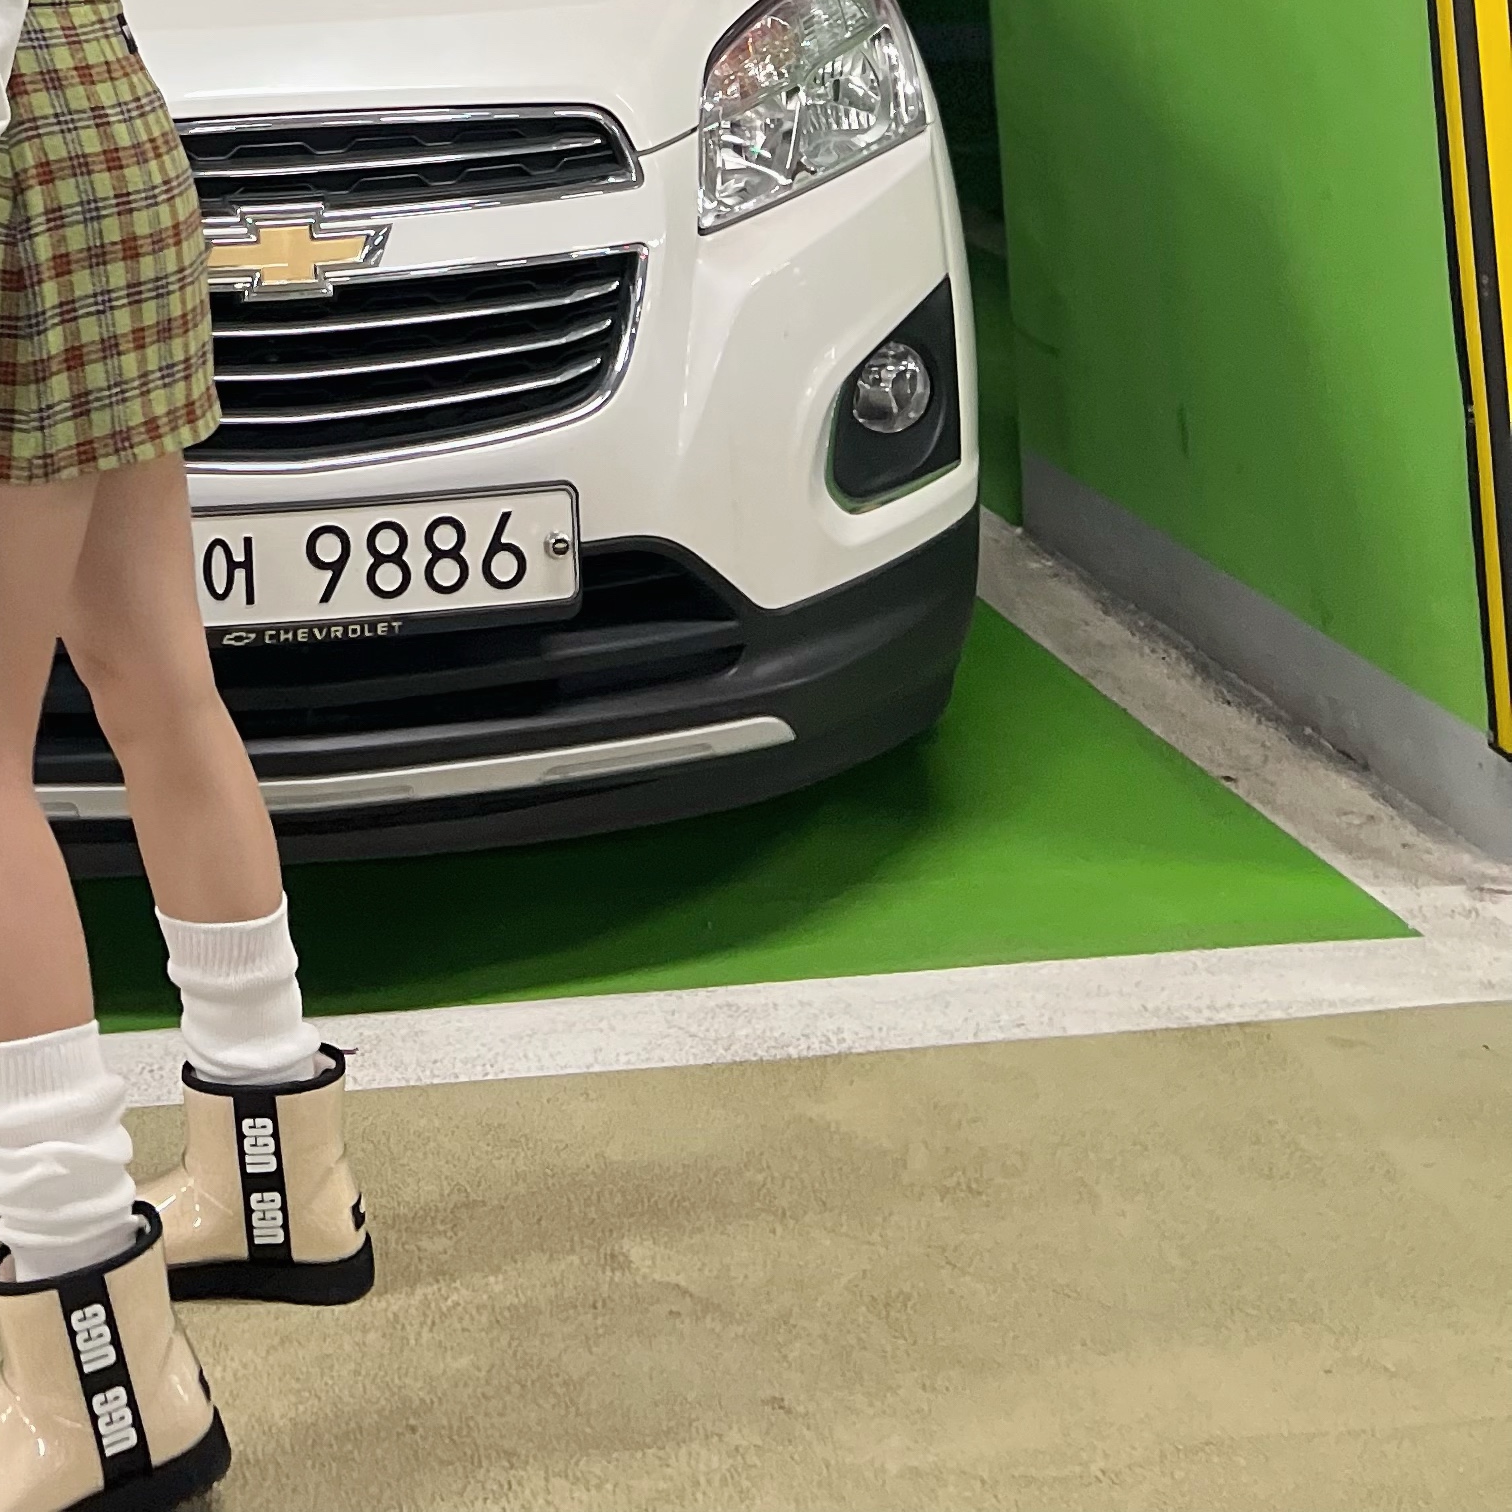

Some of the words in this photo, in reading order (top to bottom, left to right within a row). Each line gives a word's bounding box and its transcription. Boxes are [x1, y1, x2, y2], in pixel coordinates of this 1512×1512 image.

[305, 510, 527, 604] 9886
[264, 621, 403, 644] CHEVROLET
[241, 1117, 278, 1174] UGG
[249, 1191, 285, 1245] UGG
[70, 1303, 117, 1374] UGG
[92, 1385, 139, 1457] UGG
